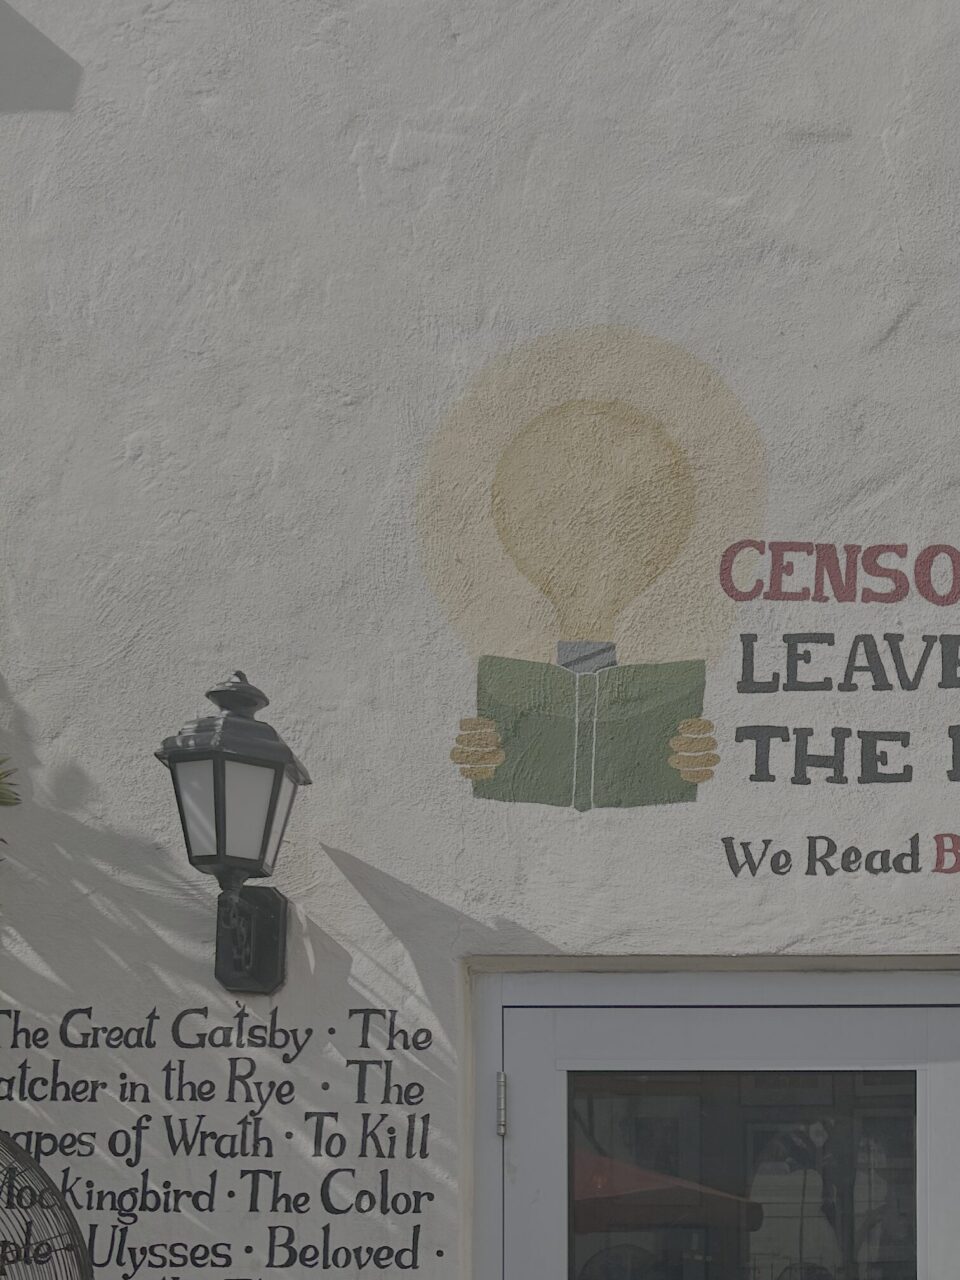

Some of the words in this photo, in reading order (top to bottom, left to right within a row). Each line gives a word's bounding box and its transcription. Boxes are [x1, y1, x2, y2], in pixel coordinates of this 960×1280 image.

[735, 725, 913, 785] THE
[721, 836, 792, 878] We
[805, 833, 922, 876] Read
[59, 1006, 160, 1049] Great
[172, 1000, 312, 1062] Gatsby
[348, 1008, 432, 1050] The
[119, 1072, 151, 1103] in
[162, 1060, 215, 1102] the
[226, 1057, 294, 1115] Rye
[346, 1060, 424, 1106] The
[108, 1114, 152, 1168] of
[163, 1115, 272, 1158] Wrath
[304, 1112, 346, 1158] To
[358, 1113, 430, 1159] Kill
[240, 1169, 310, 1214] The
[320, 1168, 434, 1215] Color
[88, 1224, 231, 1279] Ulysses
[265, 1223, 421, 1270] Beloved
